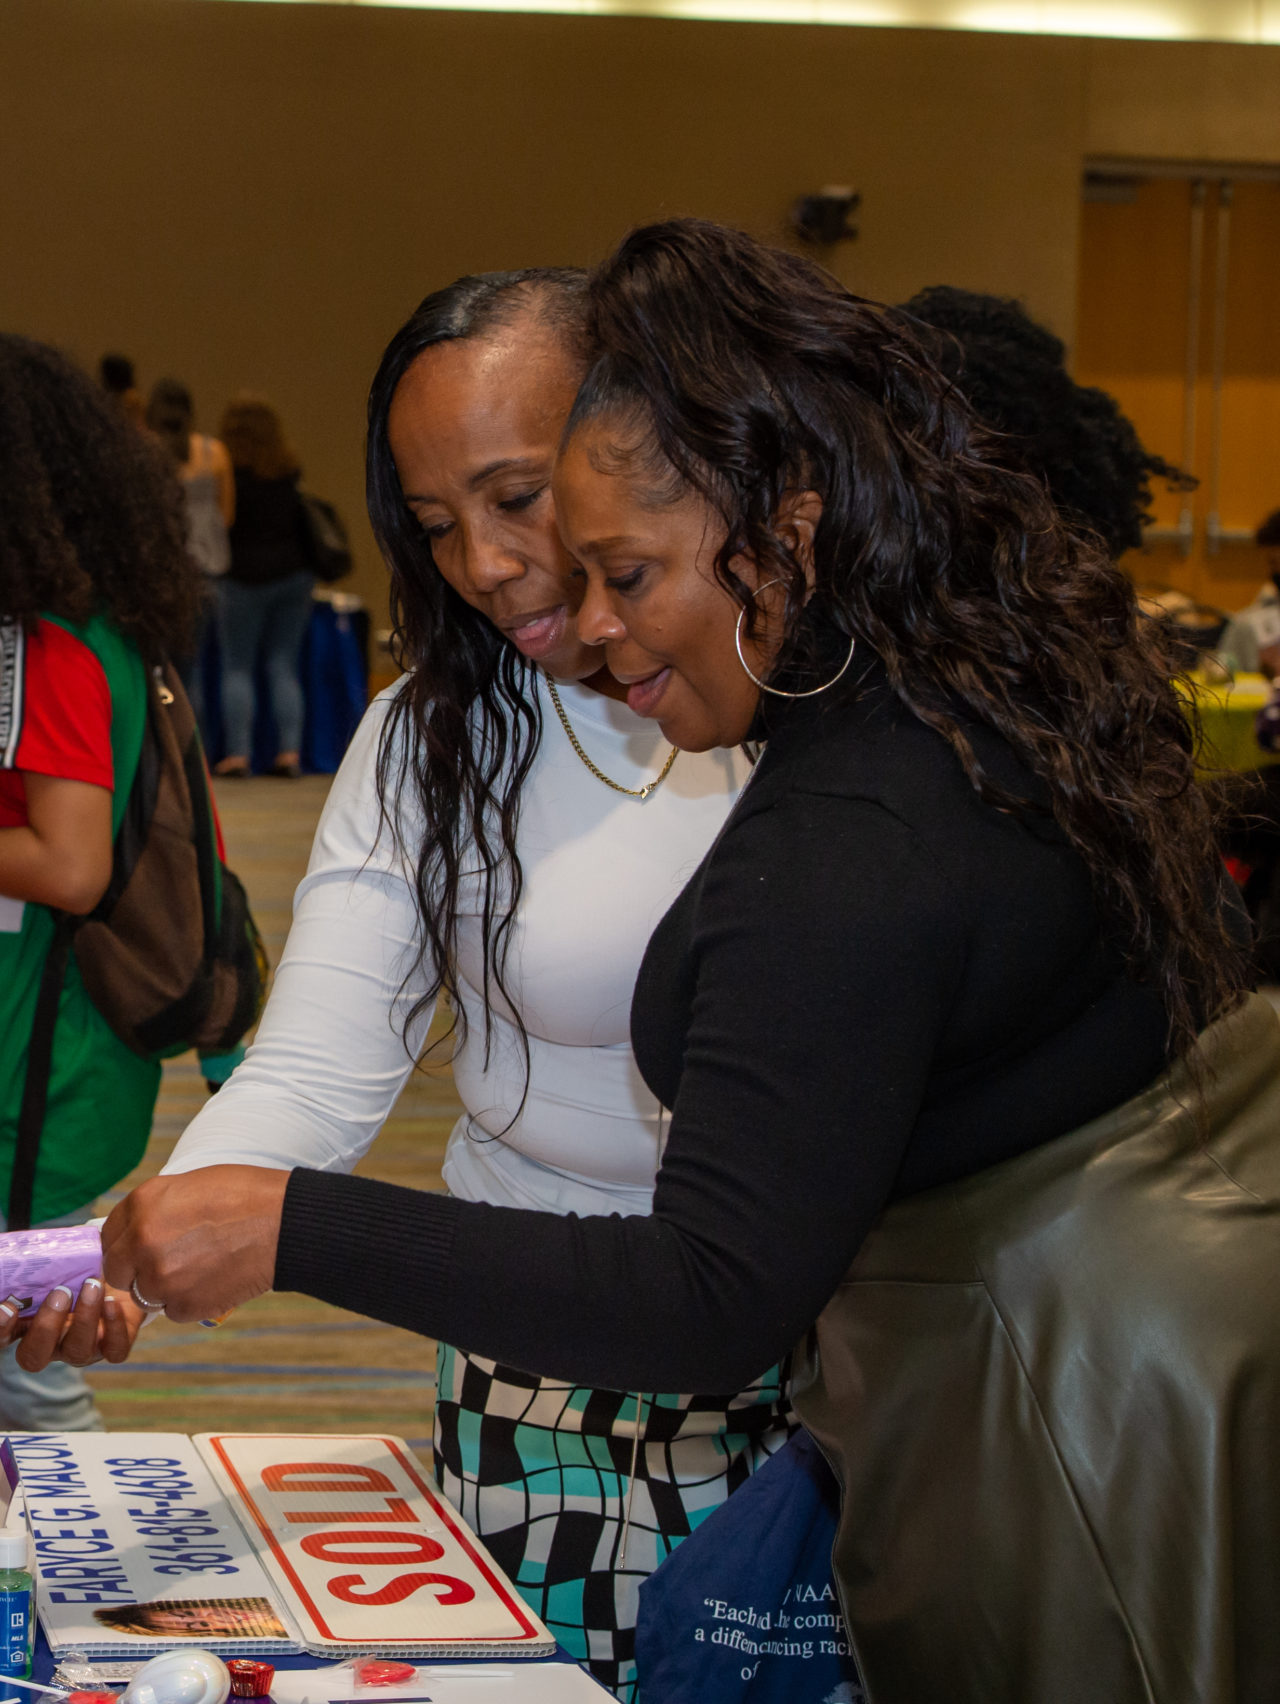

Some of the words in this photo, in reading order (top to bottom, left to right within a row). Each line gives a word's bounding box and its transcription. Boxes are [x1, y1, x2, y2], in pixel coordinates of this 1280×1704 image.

[18, 1503, 101, 1522] G.
[103, 1457, 240, 1576] 361-815-4608
[260, 1462, 476, 1606] SOLD
[34, 1528, 138, 1604] FARYCE
[694, 1627, 705, 1642] a
